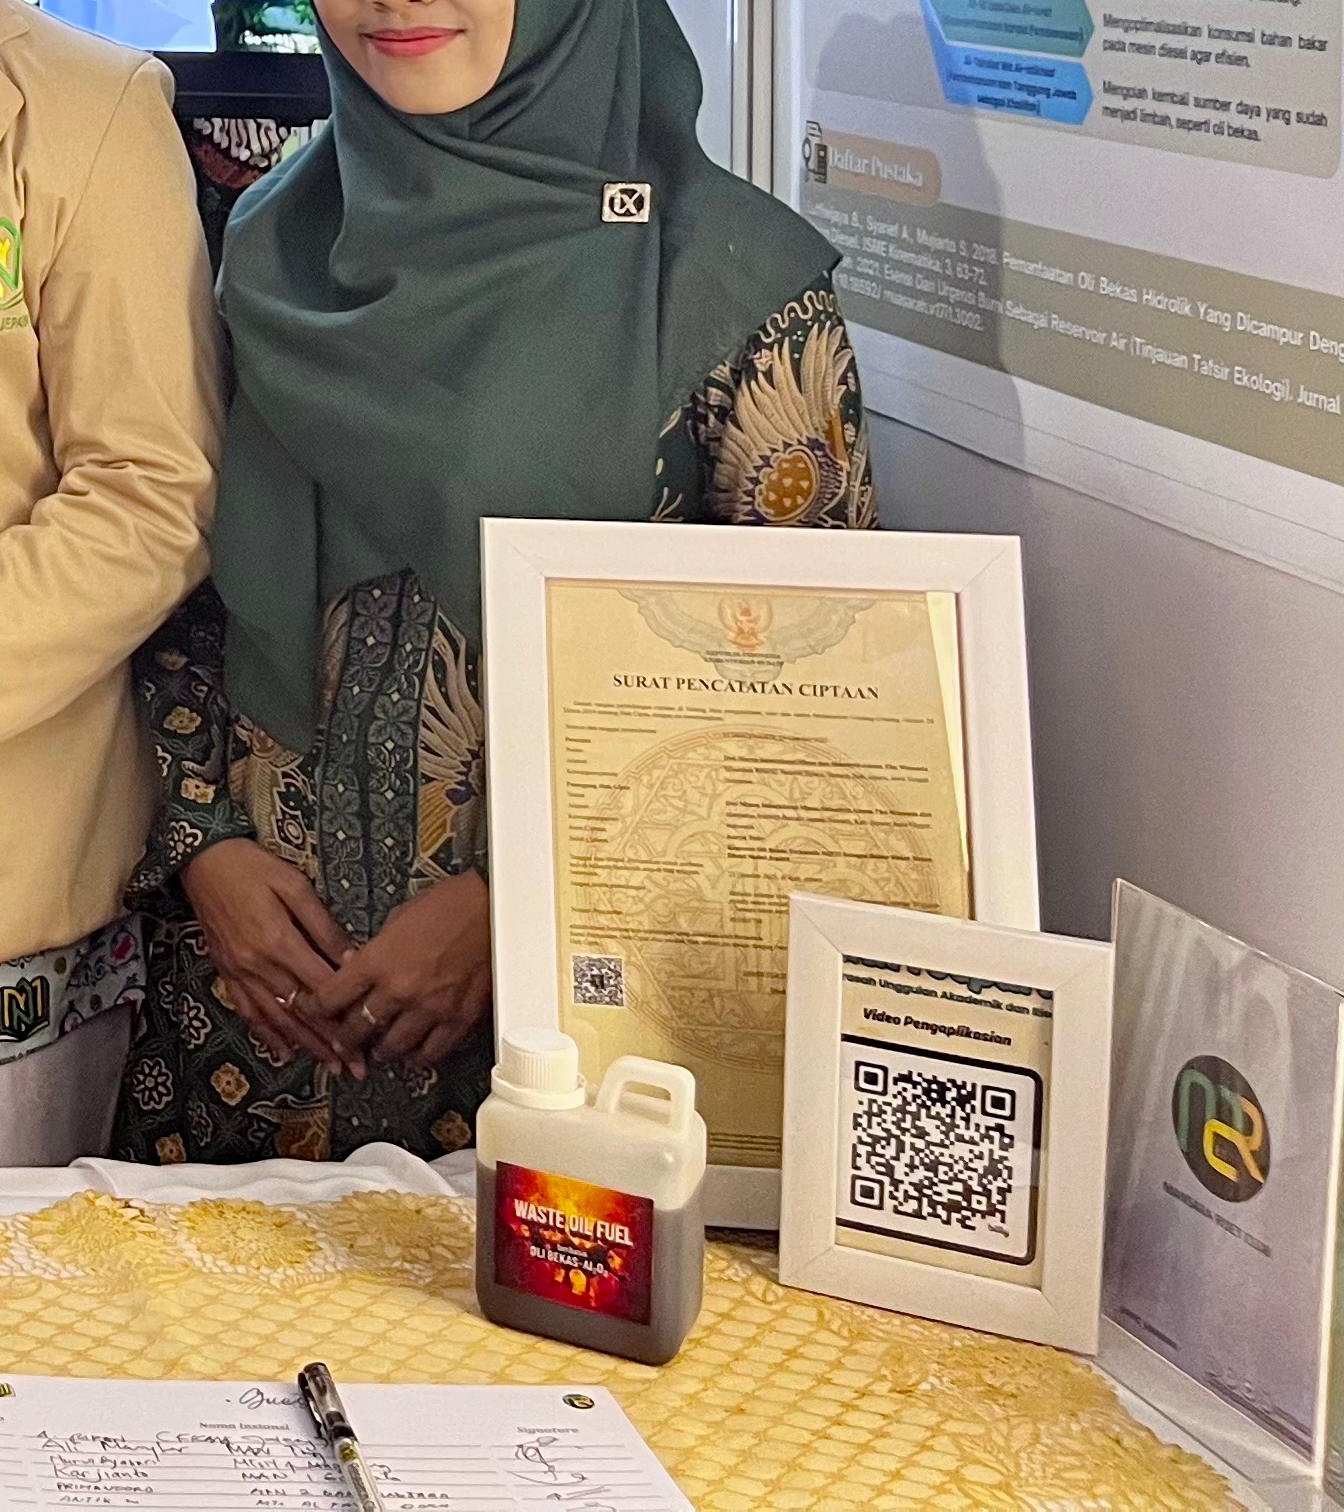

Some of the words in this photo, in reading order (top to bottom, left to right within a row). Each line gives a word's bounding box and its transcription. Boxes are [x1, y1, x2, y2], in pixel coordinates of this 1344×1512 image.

[1235, 99, 1262, 120] daya
[1265, 106, 1292, 126] yang
[1077, 271, 1096, 292] Oli
[1098, 276, 1138, 304] Bekas
[1141, 288, 1193, 317] Hidrolik
[1195, 300, 1232, 332] Yang
[1235, 311, 1305, 348] Dicampur
[1050, 314, 1107, 346] Reservoir
[1109, 331, 1129, 352] Air
[1191, 354, 1230, 382] Tafsir
[1296, 384, 1342, 416] Jurnal
[612, 674, 673, 690] SURAT
[675, 677, 794, 697] PENCATATAN
[798, 683, 880, 700] CIPTAAN
[878, 978, 938, 998] Unggulan
[939, 991, 1003, 1010] Akademik
[1004, 1002, 1030, 1016] dan
[863, 1007, 902, 1027] Video
[903, 1015, 1013, 1047] Pengaplikasian
[514, 1198, 565, 1229] WASTE
[568, 1213, 593, 1237] OIL
[596, 1219, 634, 1248] FUEL
[529, 1245, 546, 1260] OLI
